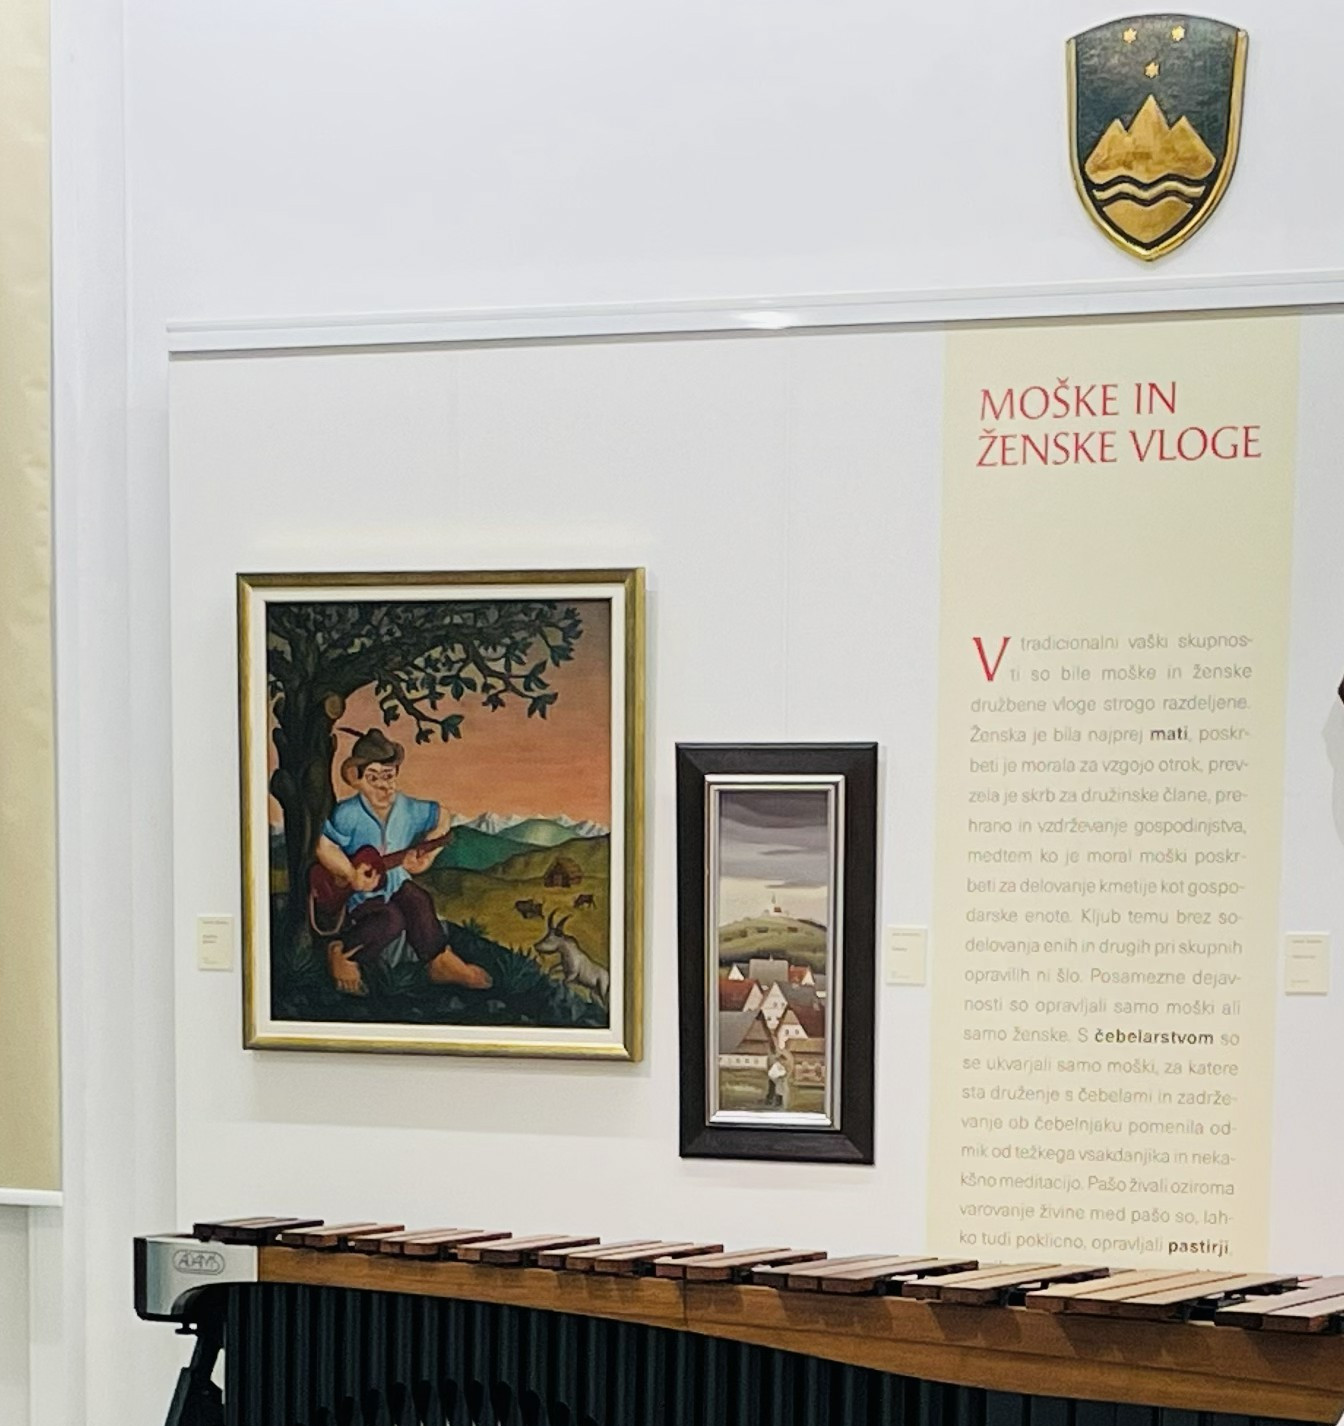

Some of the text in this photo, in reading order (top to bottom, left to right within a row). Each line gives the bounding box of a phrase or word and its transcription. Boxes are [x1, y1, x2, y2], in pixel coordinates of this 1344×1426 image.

[979, 376, 1177, 421] MOŠKE IN
[976, 425, 1262, 467] ŽENSKE VLOGE
[972, 631, 1253, 682] V tradicionalni vaški skupnos-
[1009, 662, 1253, 682] ti so bile moške in ženske
[969, 695, 1047, 713] družbene
[1051, 695, 1097, 716] vloge
[1102, 694, 1156, 716] strogo
[968, 725, 1027, 743] Ženska
[1031, 726, 1047, 747] je
[1051, 725, 1082, 743] bila
[1086, 725, 1144, 746] najprej
[968, 756, 999, 774] beti
[1001, 756, 1017, 777] je
[1020, 756, 1076, 773] morala
[1078, 760, 1098, 773] za
[1101, 756, 1155, 777] vzgojo
[1206, 759, 1249, 777] prev-
[967, 785, 1000, 802] zela
[1001, 785, 1018, 806] je
[1020, 785, 1056, 802] skrb
[1058, 789, 1078, 802] za
[1079, 785, 1160, 802] družinske
[1214, 789, 1248, 806] pre-
[967, 816, 1013, 833] hrano
[1017, 816, 1032, 833] in
[1036, 816, 1128, 837] vzdrževanje
[966, 846, 1033, 863] medtem
[1038, 846, 1059, 863] ko
[1064, 846, 1080, 867] je
[1085, 846, 1133, 863] moral
[1137, 846, 1188, 863] moški
[965, 875, 1245, 898] beti za delovanje kmetije kot gospo-
[964, 905, 1018, 923] darske
[1079, 906, 1122, 928] Kljub
[1126, 907, 1169, 924] temu
[1175, 907, 1212, 924] brez
[963, 935, 1243, 959] delovanja enih in drugih pri skupnih
[963, 965, 1031, 987] opravilih
[1035, 966, 1051, 983] ni
[1089, 967, 1187, 985] Posamezne
[1191, 968, 1241, 989] dejav-
[963, 995, 1241, 1018] nosti so opravljali samo moški ali
[963, 1028, 1007, 1041] samo
[1076, 1026, 1089, 1043] S
[1094, 1027, 1214, 1045] čebelarstvom
[1218, 1032, 1240, 1046] so
[962, 1057, 981, 1069] se
[985, 1054, 1052, 1076] ukvarjali
[1057, 1059, 1103, 1072] samo
[1163, 1061, 1183, 1075] za
[1188, 1058, 1239, 1076] katere
[960, 1083, 1238, 1106] sta druženje s čebelami in zadrže-
[960, 1112, 1004, 1134] vanje
[1008, 1113, 1030, 1131] ob
[1033, 1114, 1123, 1137] čebelnjaku
[1127, 1116, 1205, 1138] pomenila
[960, 1141, 989, 1159] mik
[990, 1142, 1013, 1160] od
[1014, 1143, 1076, 1165] težkega
[1078, 1144, 1171, 1167] vsakdanjika
[1173, 1147, 1189, 1164] in
[959, 1170, 998, 1188] kšno
[1086, 1174, 1127, 1192] Pašo
[1128, 1175, 1169, 1193] živali
[1169, 1176, 1235, 1195] oziroma
[958, 1200, 1035, 1223] varovanje
[1038, 1202, 1085, 1221] živine
[1088, 1204, 1126, 1222] med
[1129, 1205, 1171, 1227] pašo
[958, 1228, 978, 1246] ko
[980, 1229, 1012, 1247] tudi
[1090, 1233, 1164, 1256] opravljali
